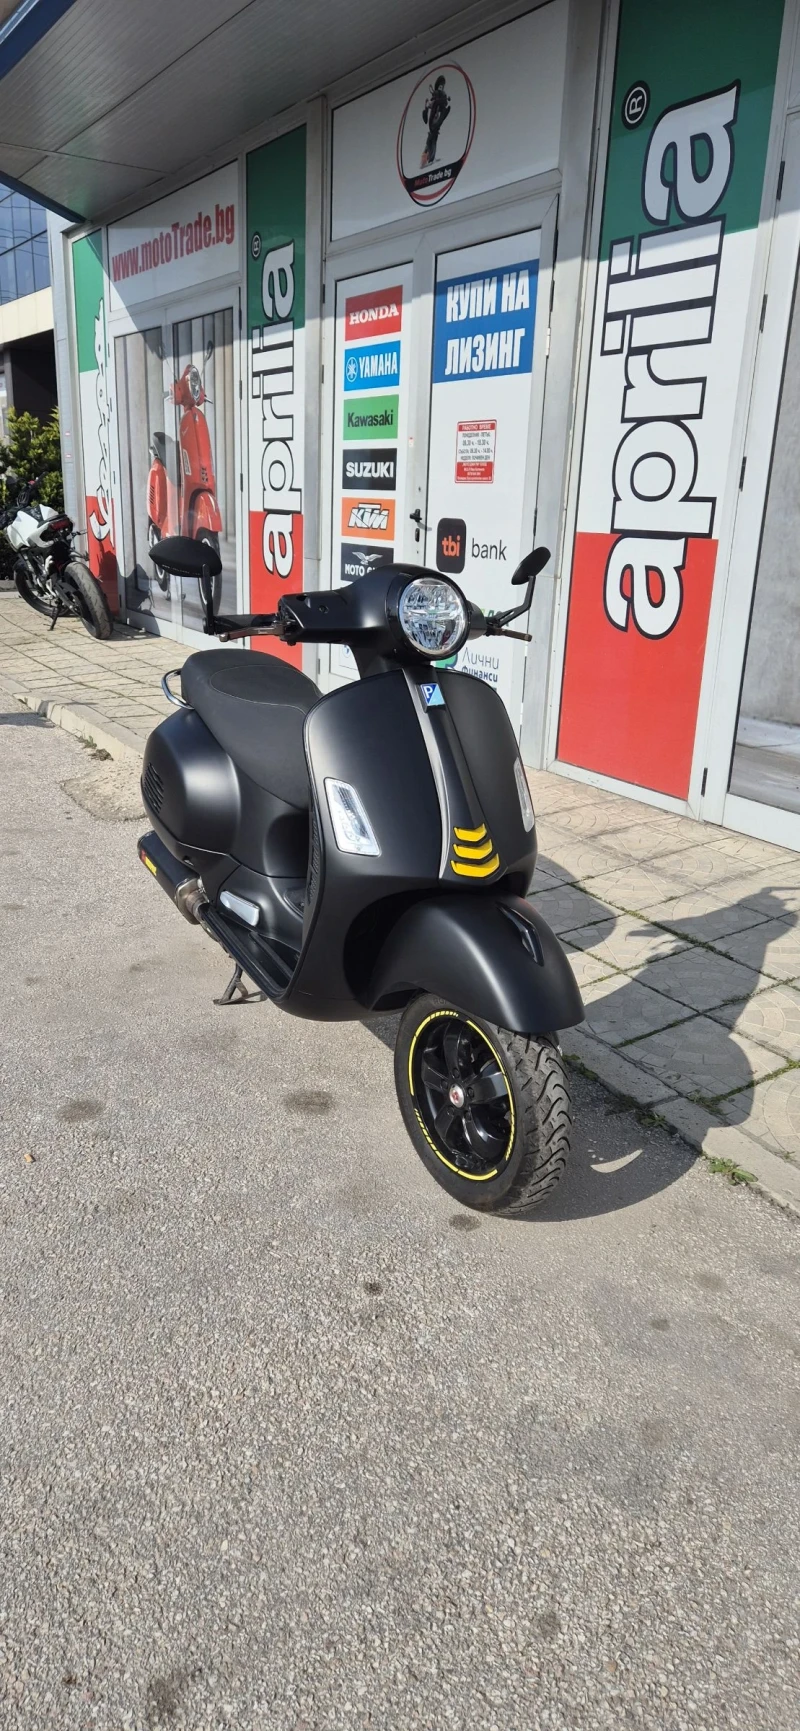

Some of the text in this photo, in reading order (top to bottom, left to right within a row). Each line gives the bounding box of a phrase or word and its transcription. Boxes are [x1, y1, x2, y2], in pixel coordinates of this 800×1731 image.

[112, 203, 235, 283] www.motoTrade.bg
[446, 269, 530, 323] КУПИ НА
[349, 303, 400, 326] HONDA
[359, 351, 398, 379] YAMAHA
[445, 328, 526, 376] ЛИЗИНГ
[600, 80, 741, 640] aprilia
[252, 239, 302, 579] aprilia
[347, 410, 394, 428] Kawasaki
[346, 461, 394, 478] SUZUKI
[348, 503, 389, 530] KTM
[441, 534, 507, 561] tbi bank
[344, 563, 365, 577] MOTO
[462, 647, 500, 670] Лични
